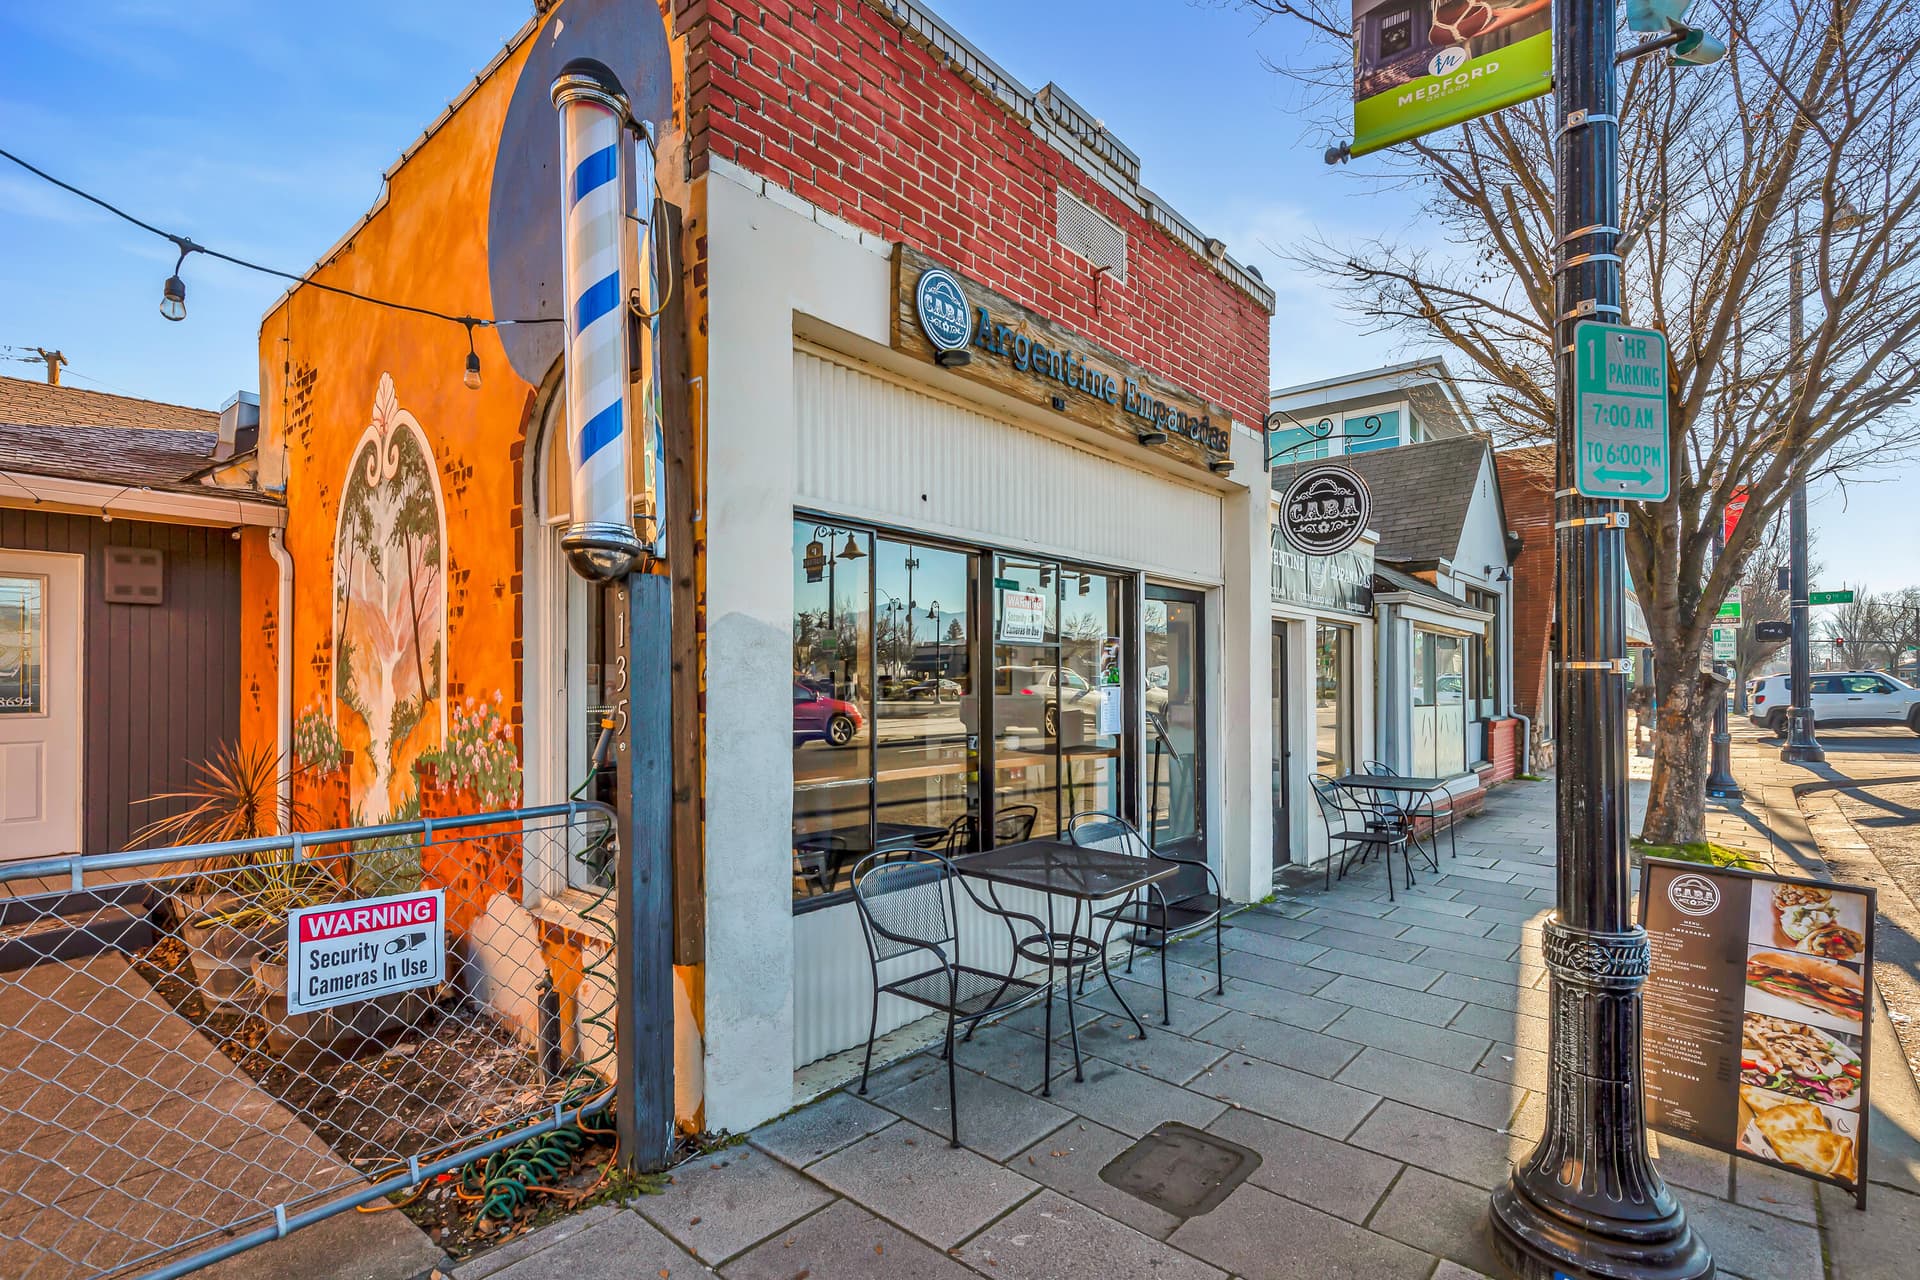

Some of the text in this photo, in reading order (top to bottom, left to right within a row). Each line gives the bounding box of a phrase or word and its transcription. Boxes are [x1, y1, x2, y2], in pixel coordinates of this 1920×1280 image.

[1397, 62, 1500, 107] MEDFORD
[1426, 83, 1470, 102] OREGON
[924, 293, 967, 328] CABA
[1588, 338, 1647, 381] 1 HR
[974, 307, 1229, 452] Argentine Empanadas
[1609, 363, 1660, 388] PARKING
[1592, 403, 1654, 429] 7:00 AM
[1586, 442, 1661, 467] TO 6:00 PM
[1289, 497, 1360, 523] CABA
[1273, 549, 1305, 572] ENTINE
[307, 901, 431, 937] WARNING
[310, 942, 379, 971] Security
[309, 958, 428, 997] Cameras In Use
